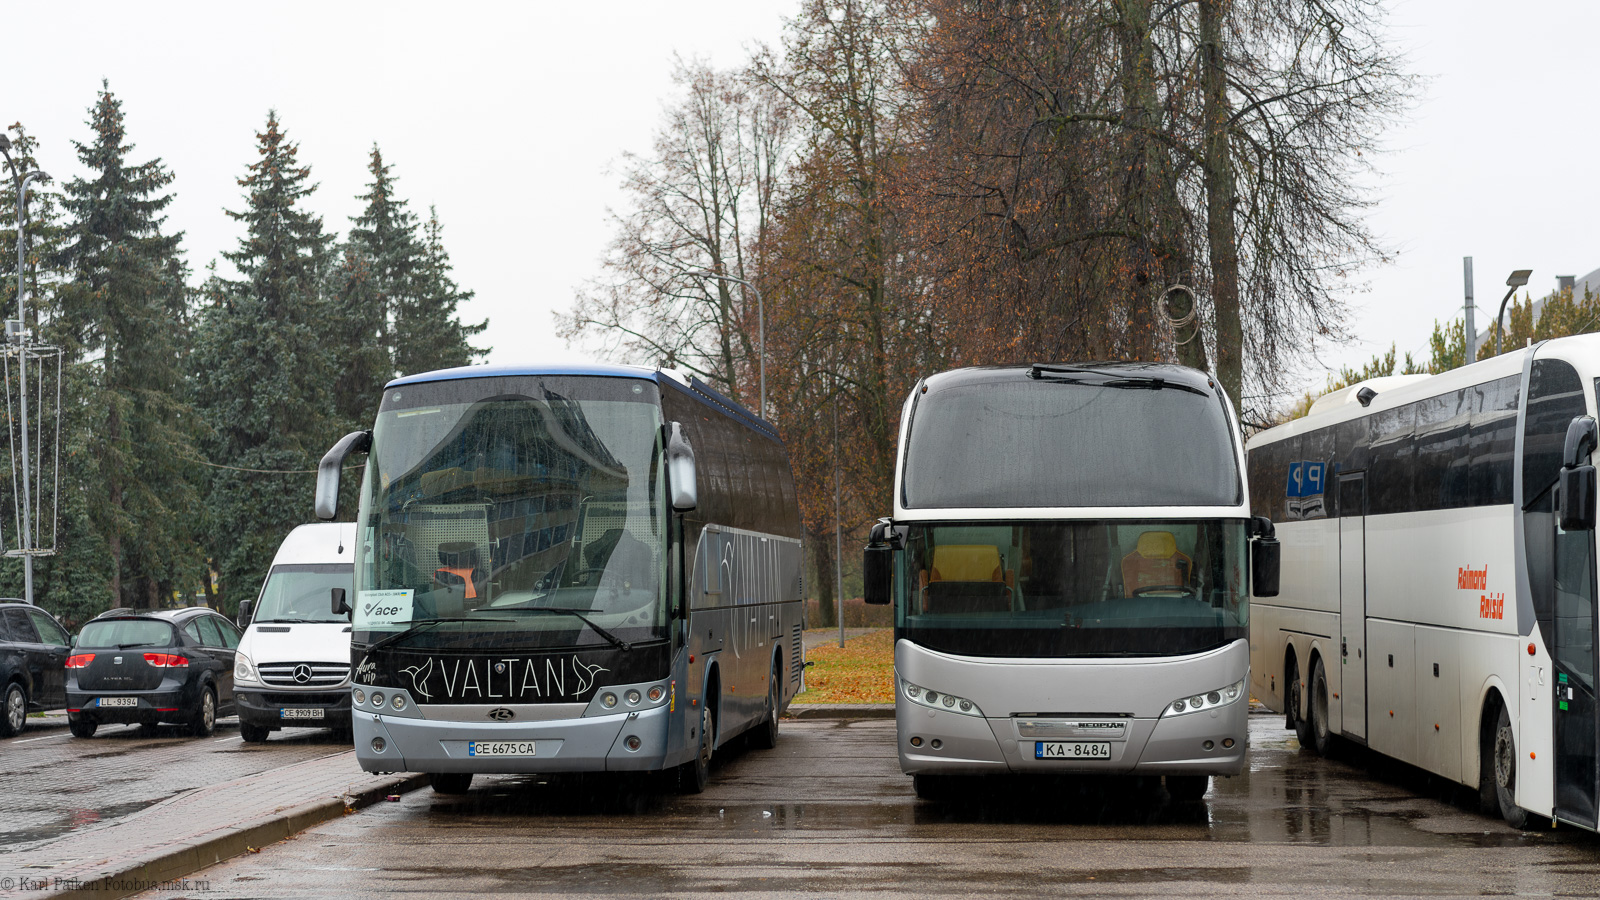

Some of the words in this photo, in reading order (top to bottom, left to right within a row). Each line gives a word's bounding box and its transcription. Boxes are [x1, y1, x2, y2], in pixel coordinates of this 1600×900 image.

[1458, 564, 1487, 590] Raimond
[1480, 592, 1504, 619] Reisid
[354, 655, 376, 682] Aura
[363, 671, 376, 685] vip
[440, 658, 564, 697] VALTAN
[475, 743, 490, 754] CE
[492, 743, 517, 754] 6675
[518, 743, 534, 754] CA
[1046, 744, 1107, 756] KA-8484
